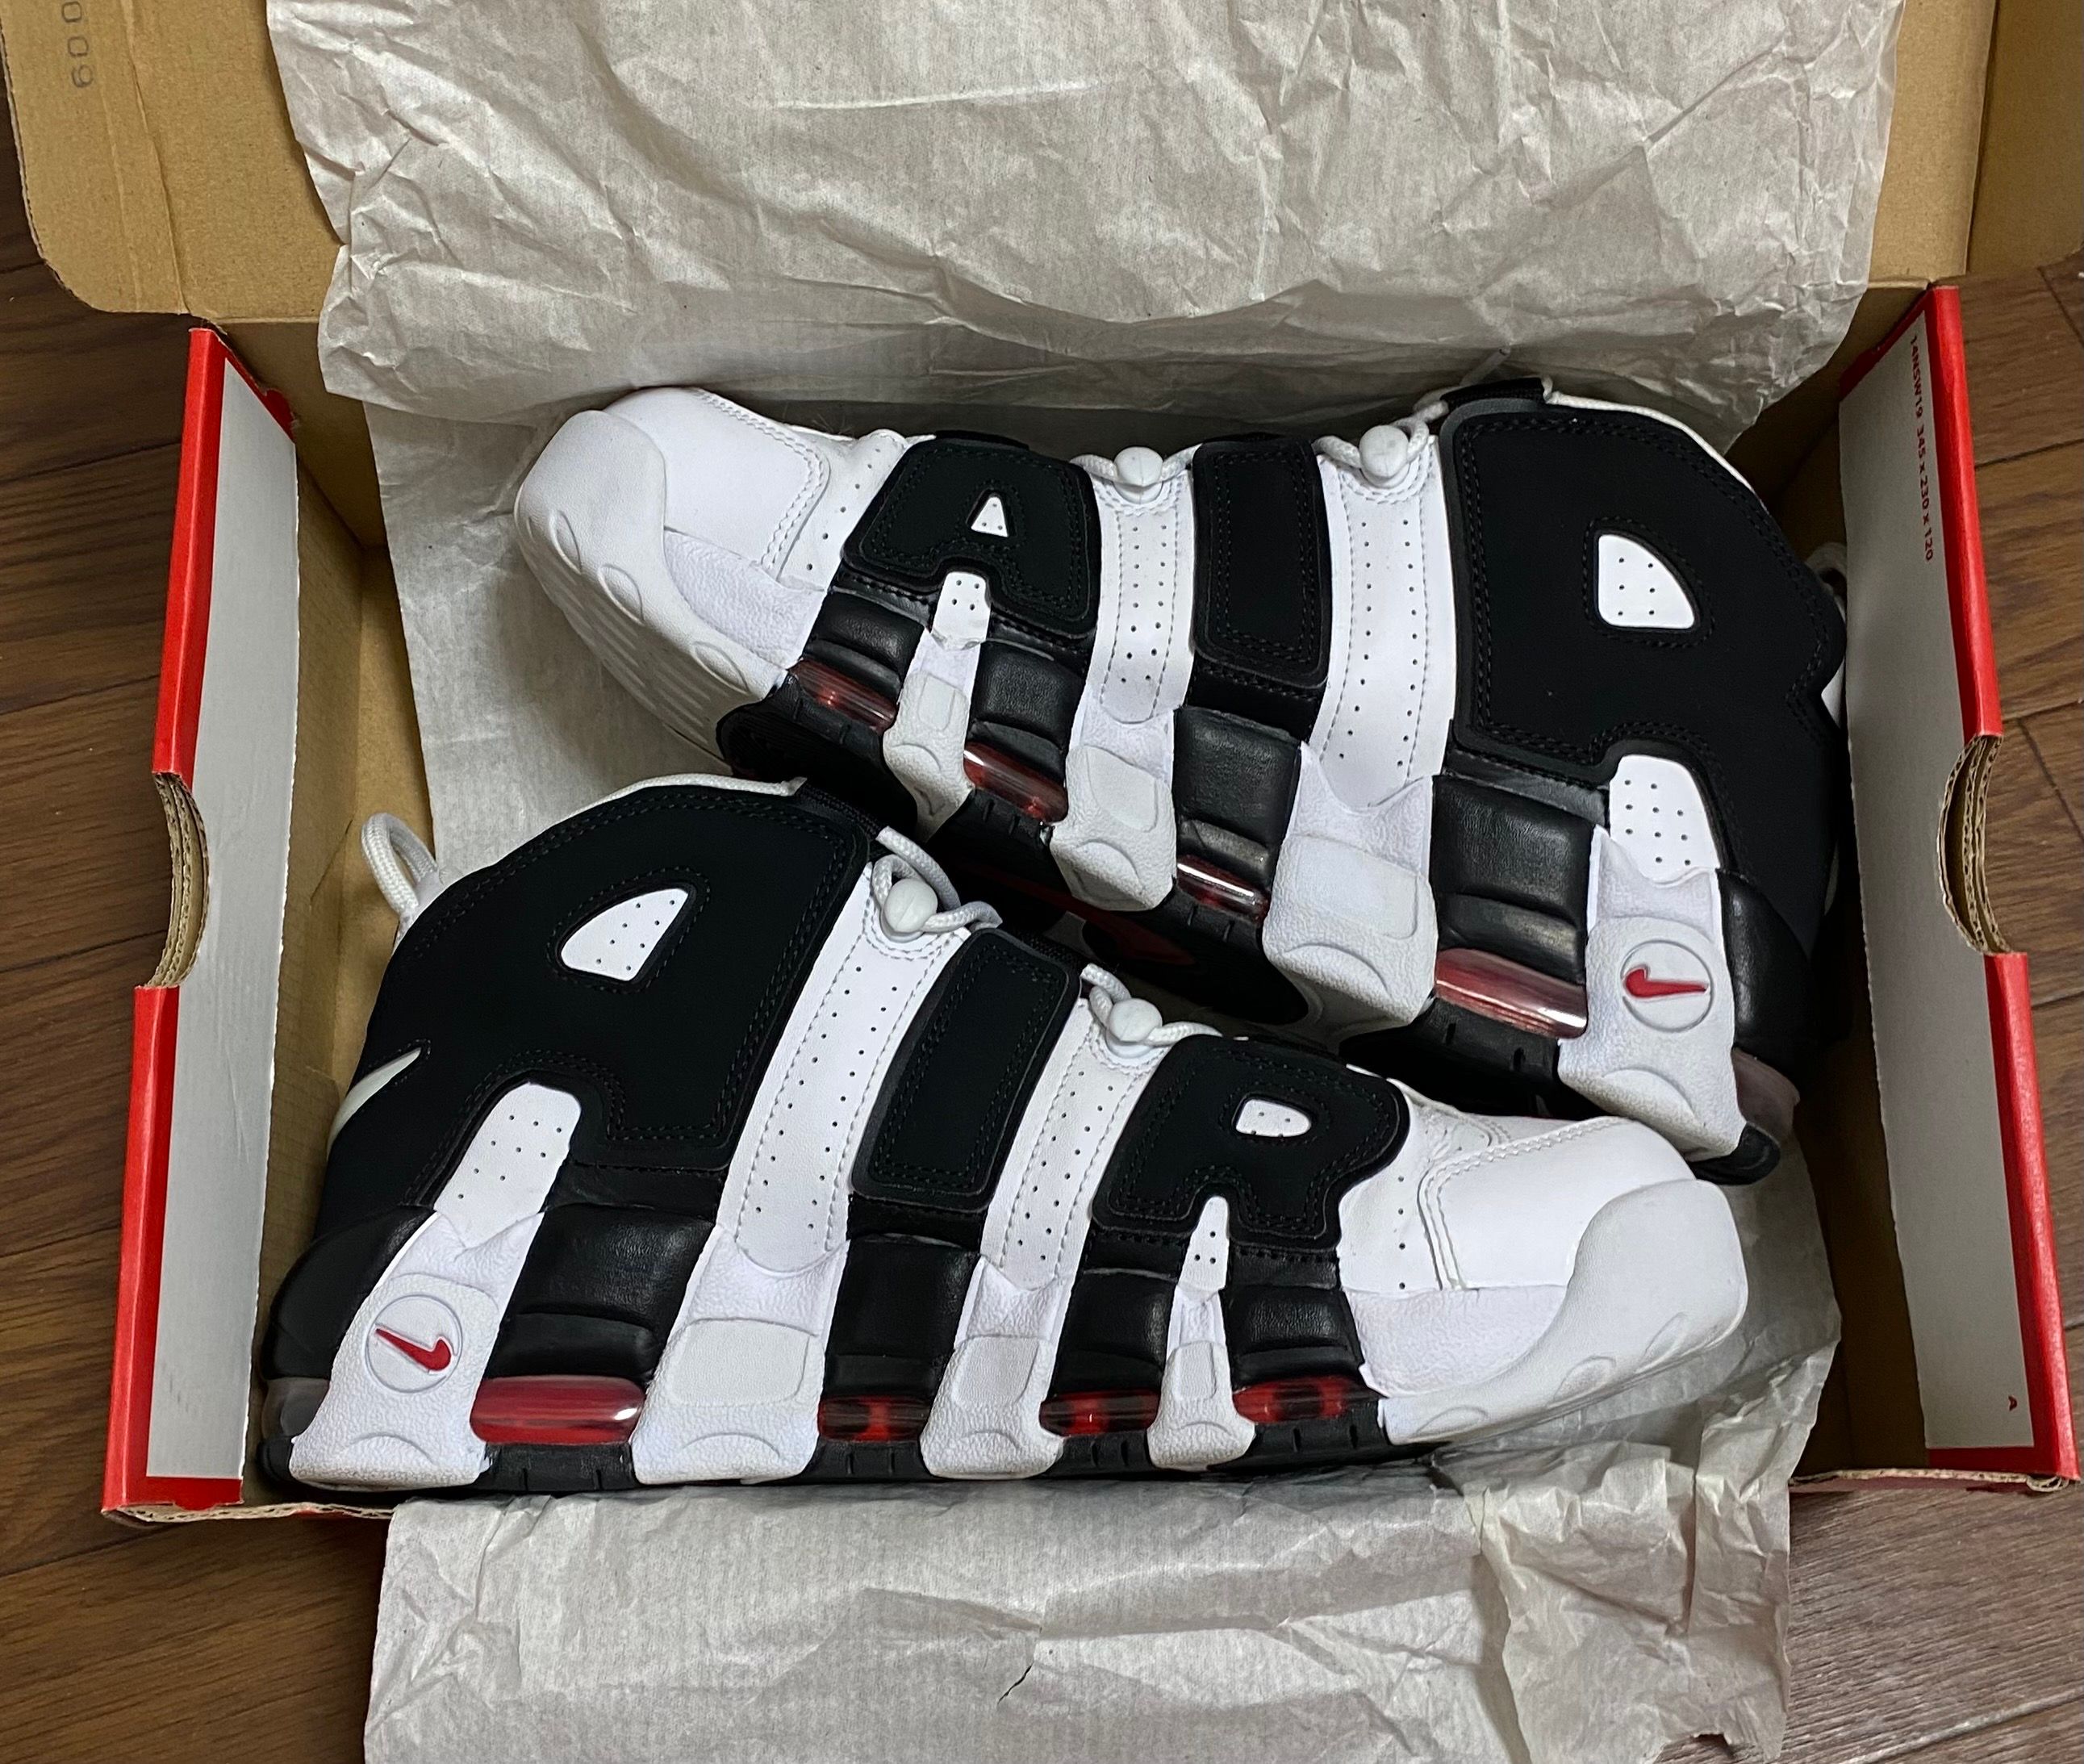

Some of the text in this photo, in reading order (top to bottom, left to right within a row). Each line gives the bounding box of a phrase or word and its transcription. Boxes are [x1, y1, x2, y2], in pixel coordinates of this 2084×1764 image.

[1917, 424, 1926, 458] 345
[1920, 474, 1930, 510] 230
[1925, 527, 1933, 561] 120
